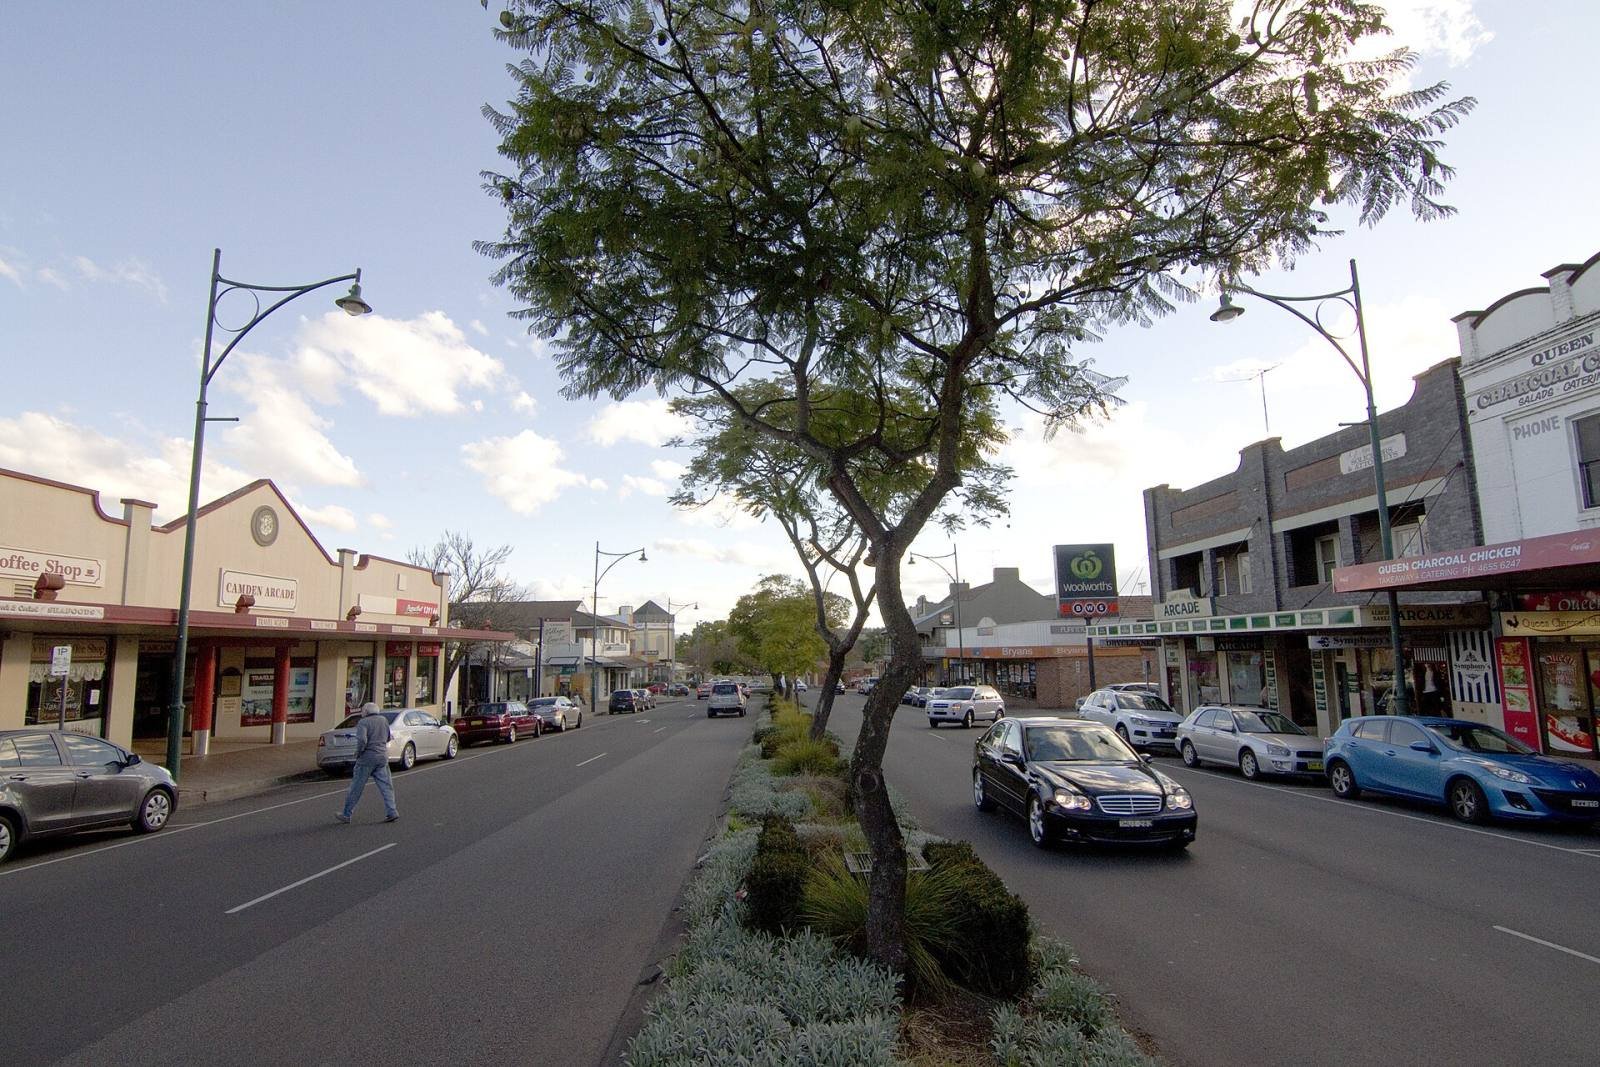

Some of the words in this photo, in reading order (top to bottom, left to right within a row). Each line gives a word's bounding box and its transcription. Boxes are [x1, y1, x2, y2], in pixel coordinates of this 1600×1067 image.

[1531, 332, 1594, 366] QUEEN
[1477, 359, 1580, 409] CHARCOAL
[1518, 389, 1554, 406] SALADS
[1563, 372, 1600, 391] CATERI
[1512, 416, 1560, 441] PHONE
[0, 554, 39, 572] offee
[45, 560, 82, 579] Shop
[1378, 562, 1409, 574] QUEEN
[1411, 556, 1466, 570] CHARCOAL
[1469, 546, 1521, 562] CHICKEN
[1378, 573, 1414, 585] TAKEAWAY
[1421, 568, 1458, 580] CATERING
[1463, 566, 1474, 576] PH
[1500, 559, 1521, 570] 6247
[225, 581, 262, 597] CAMDEN
[265, 586, 295, 600] ARCADE
[1164, 601, 1200, 617] ARCADE
[1399, 608, 1456, 620] ARCADE
[1001, 646, 1033, 658] Bryans
